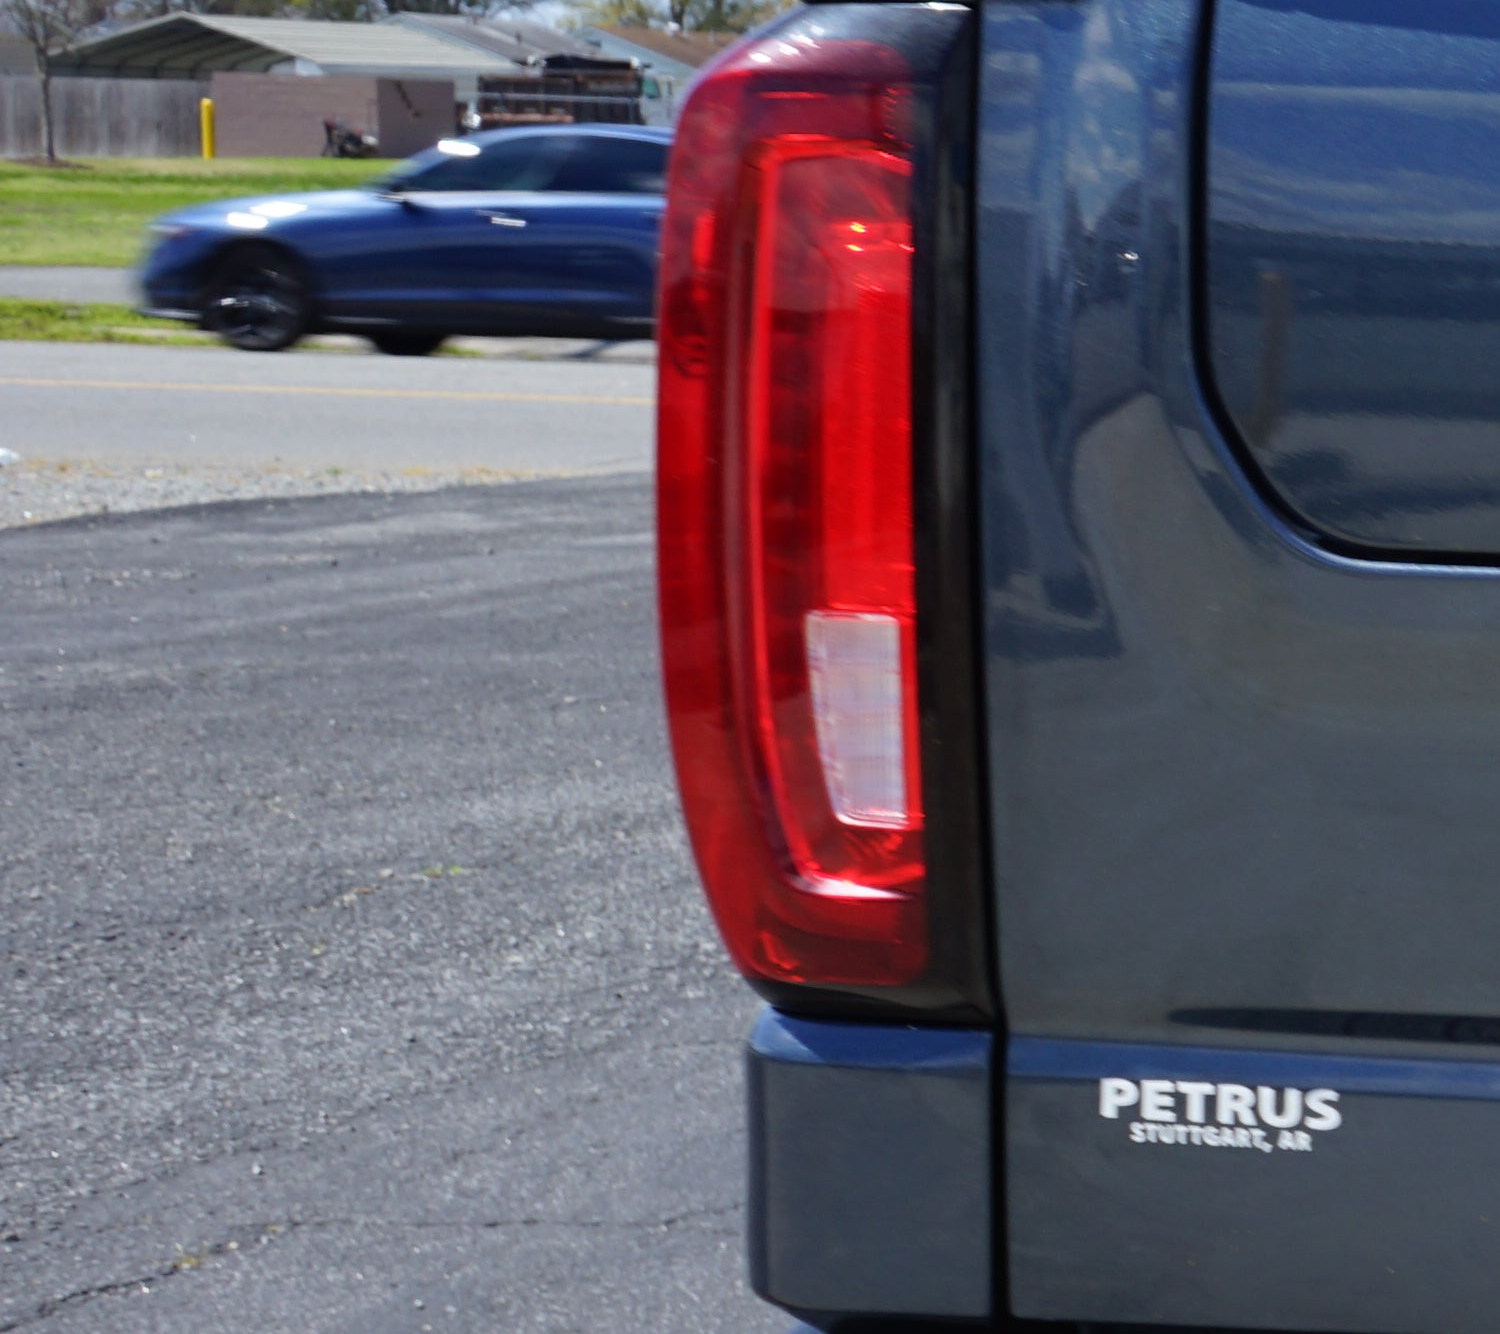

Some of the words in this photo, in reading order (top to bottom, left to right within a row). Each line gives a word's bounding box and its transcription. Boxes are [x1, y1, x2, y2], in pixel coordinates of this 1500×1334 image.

[1099, 1077, 1342, 1131] PETRUS
[1129, 1121, 1273, 1153] STUTTGART,
[1277, 1129, 1313, 1152] AR
